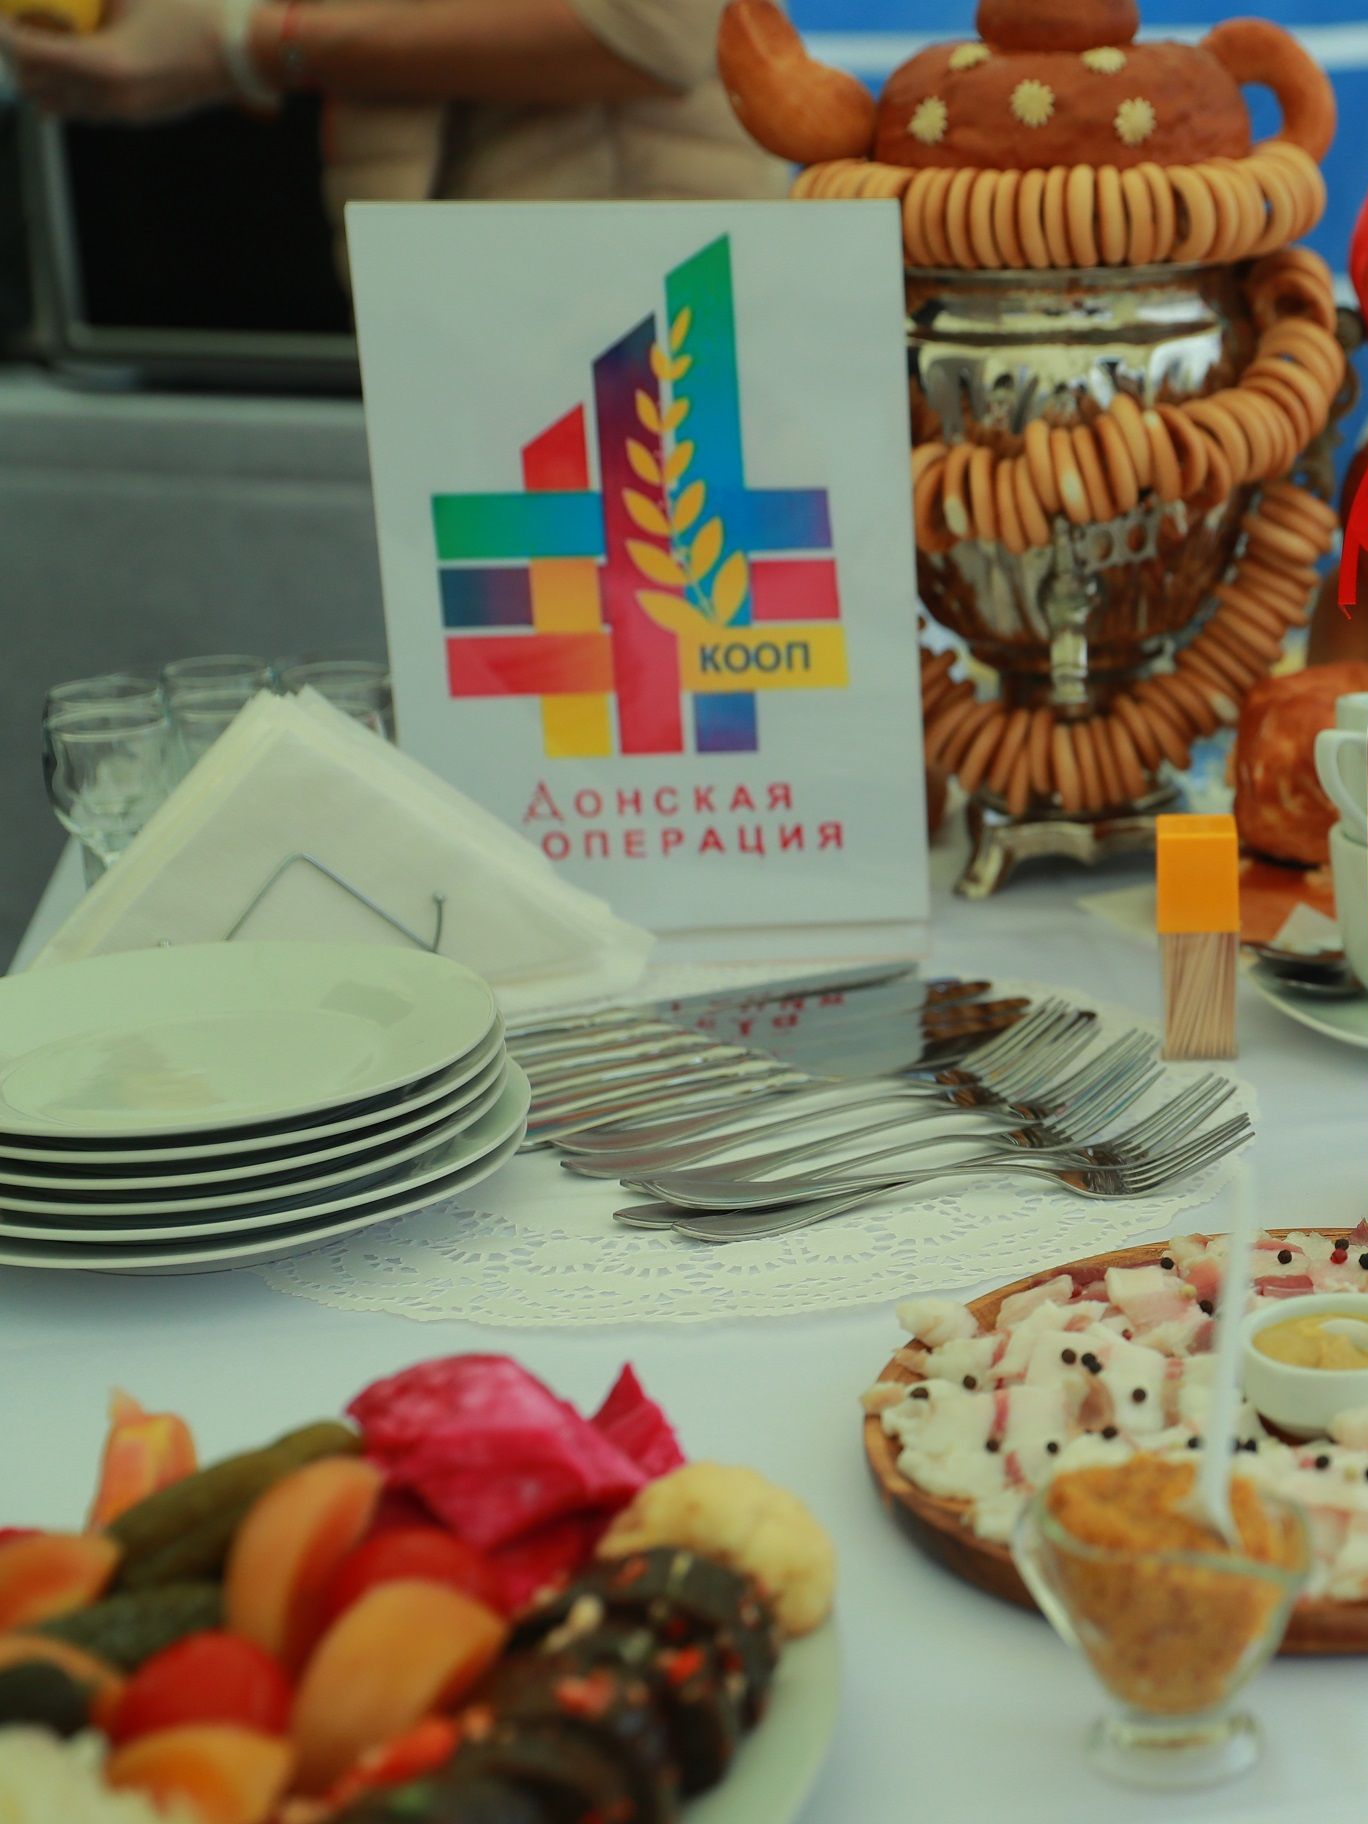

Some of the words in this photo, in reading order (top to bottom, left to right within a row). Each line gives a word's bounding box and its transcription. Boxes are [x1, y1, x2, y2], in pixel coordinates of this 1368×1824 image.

[700, 640, 811, 674] КООП
[522, 779, 793, 826] ДОНСКАЯ
[541, 820, 844, 862] ОПЕРАЦИЯ
